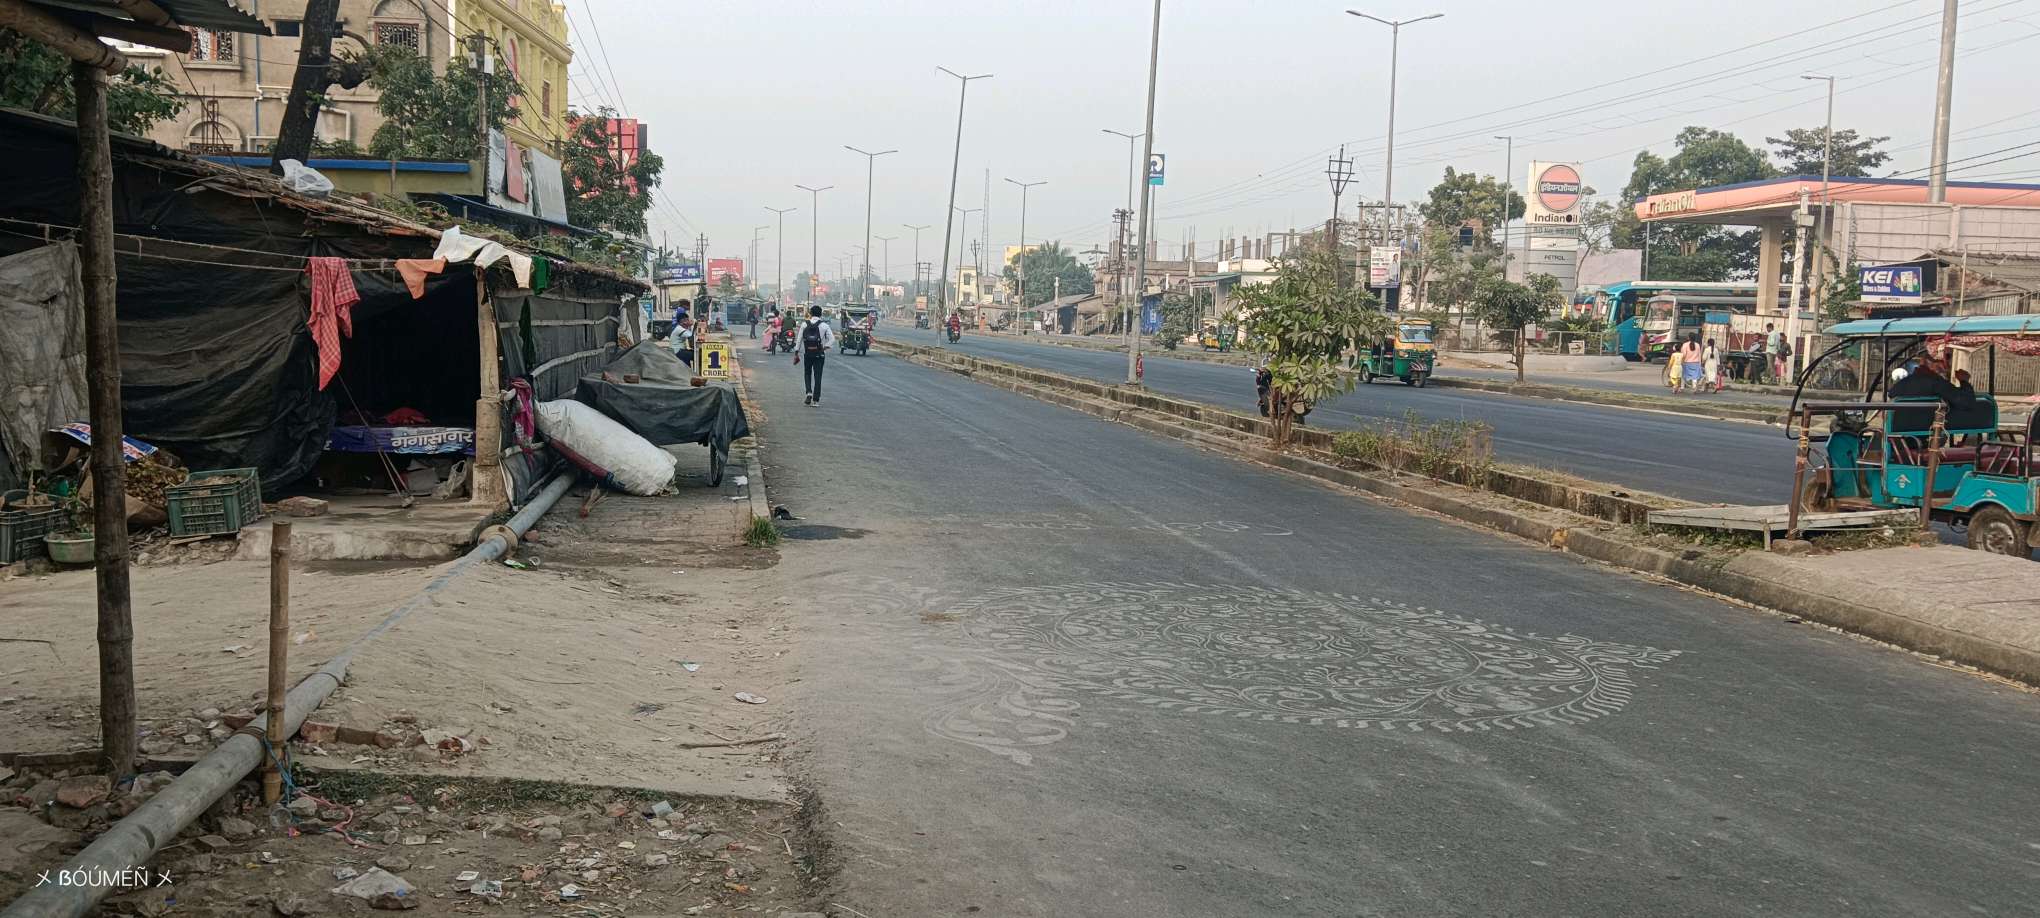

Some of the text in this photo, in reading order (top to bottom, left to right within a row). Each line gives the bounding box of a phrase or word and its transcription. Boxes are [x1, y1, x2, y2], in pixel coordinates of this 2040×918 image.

[1534, 213, 1578, 222] IndianOil
[1862, 270, 1894, 284] KEI
[707, 351, 722, 369] 1
[391, 431, 473, 448] गंगासागर
